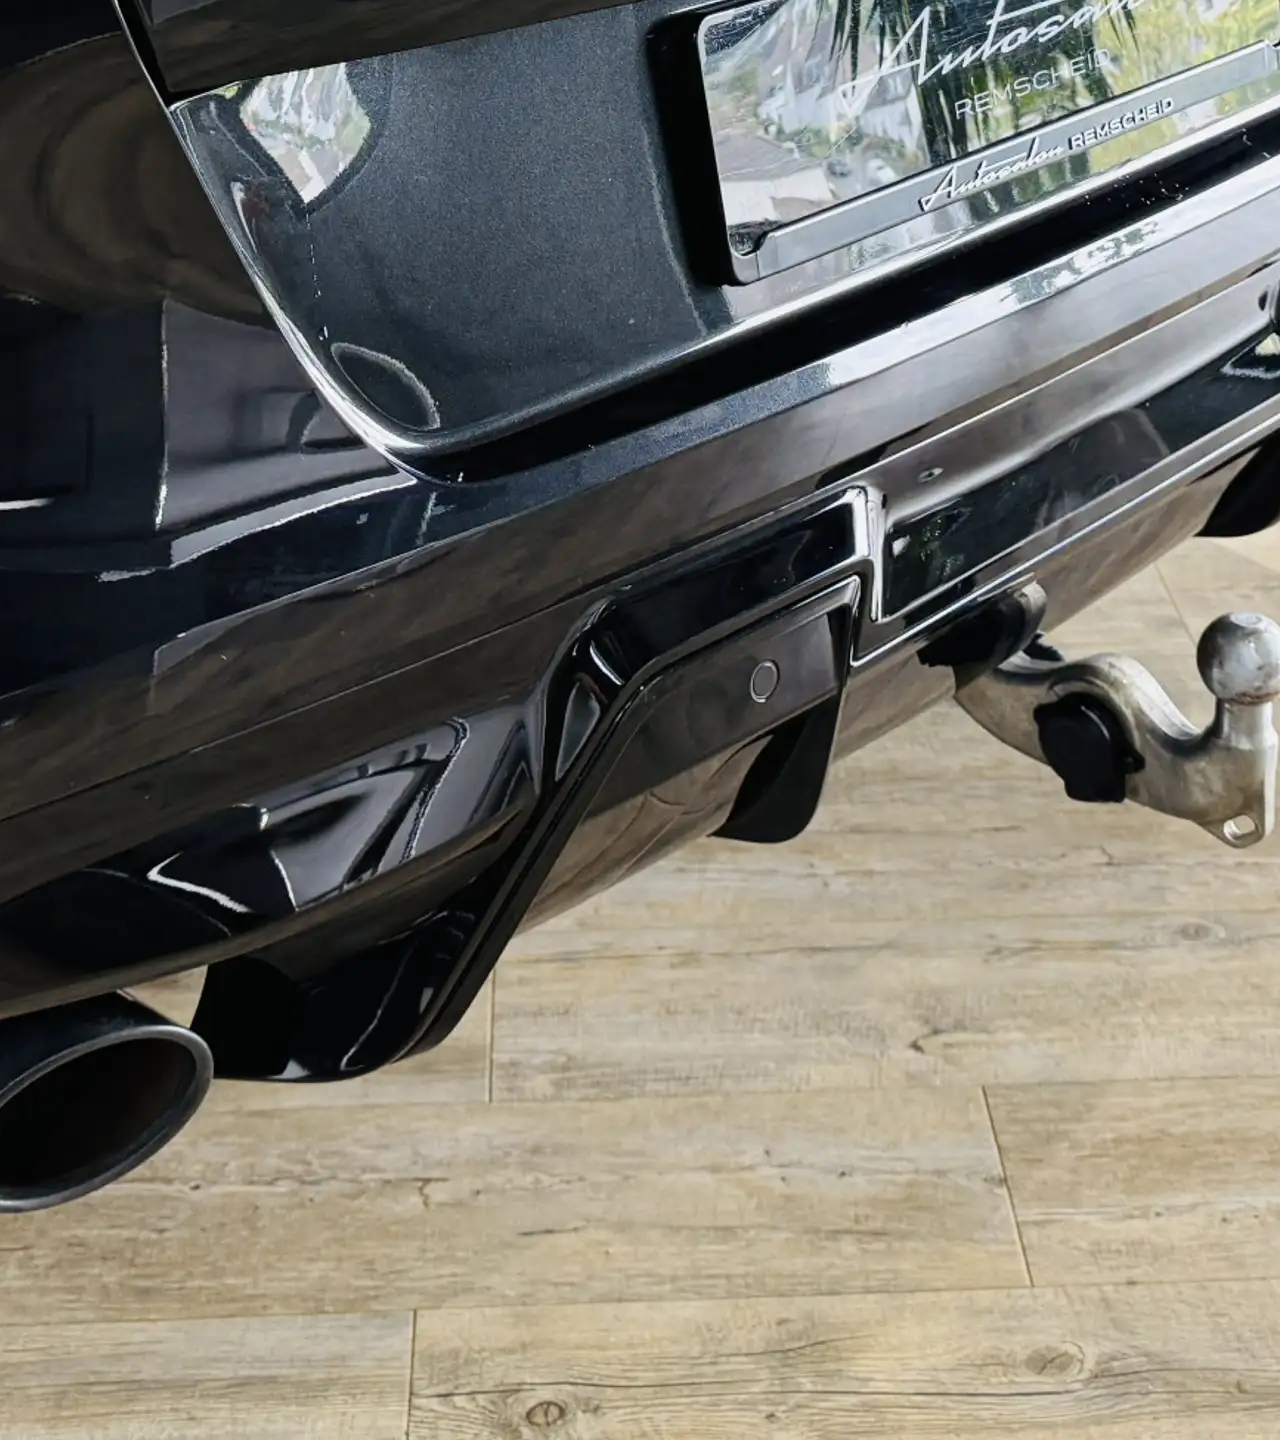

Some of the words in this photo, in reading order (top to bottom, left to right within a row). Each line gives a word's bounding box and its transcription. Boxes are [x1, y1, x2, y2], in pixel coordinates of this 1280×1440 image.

[954, 47, 1111, 120] REMSCHEID
[918, 136, 1064, 211] Autosalon
[1068, 97, 1175, 150] REMSCHEID
